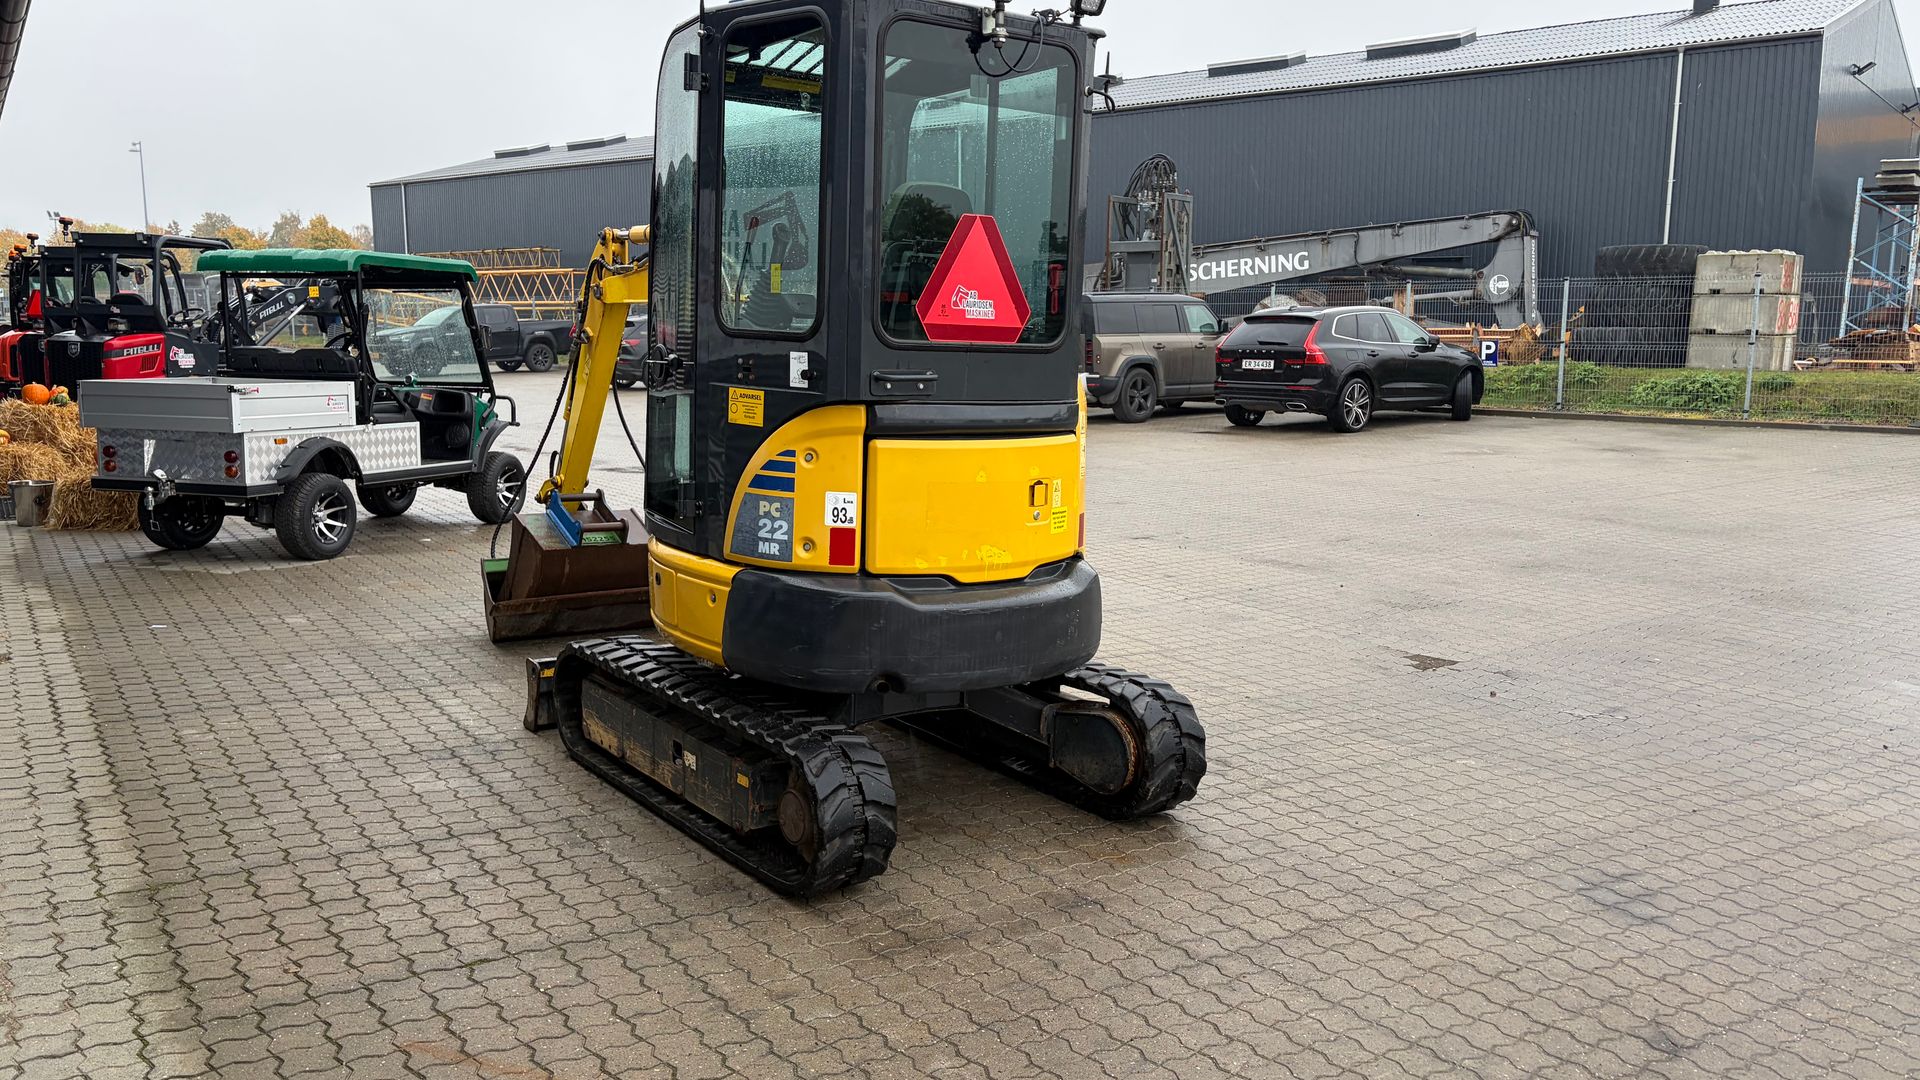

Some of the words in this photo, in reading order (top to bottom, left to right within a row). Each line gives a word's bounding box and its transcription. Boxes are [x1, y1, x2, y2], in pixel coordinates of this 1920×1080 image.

[1184, 251, 1310, 282] SCHERNING
[969, 291, 977, 299] AB
[260, 301, 285, 320] PITBULL
[962, 300, 993, 309] LAURIDSEN
[966, 309, 995, 318] MASKINER
[123, 344, 159, 356] PITBULL
[1481, 341, 1496, 360] P
[1244, 360, 1252, 368] ER
[739, 392, 762, 401] ADVARSEL
[759, 501, 781, 518] PC
[832, 507, 847, 524] 93
[757, 518, 789, 540] 22
[758, 541, 780, 555] MR
